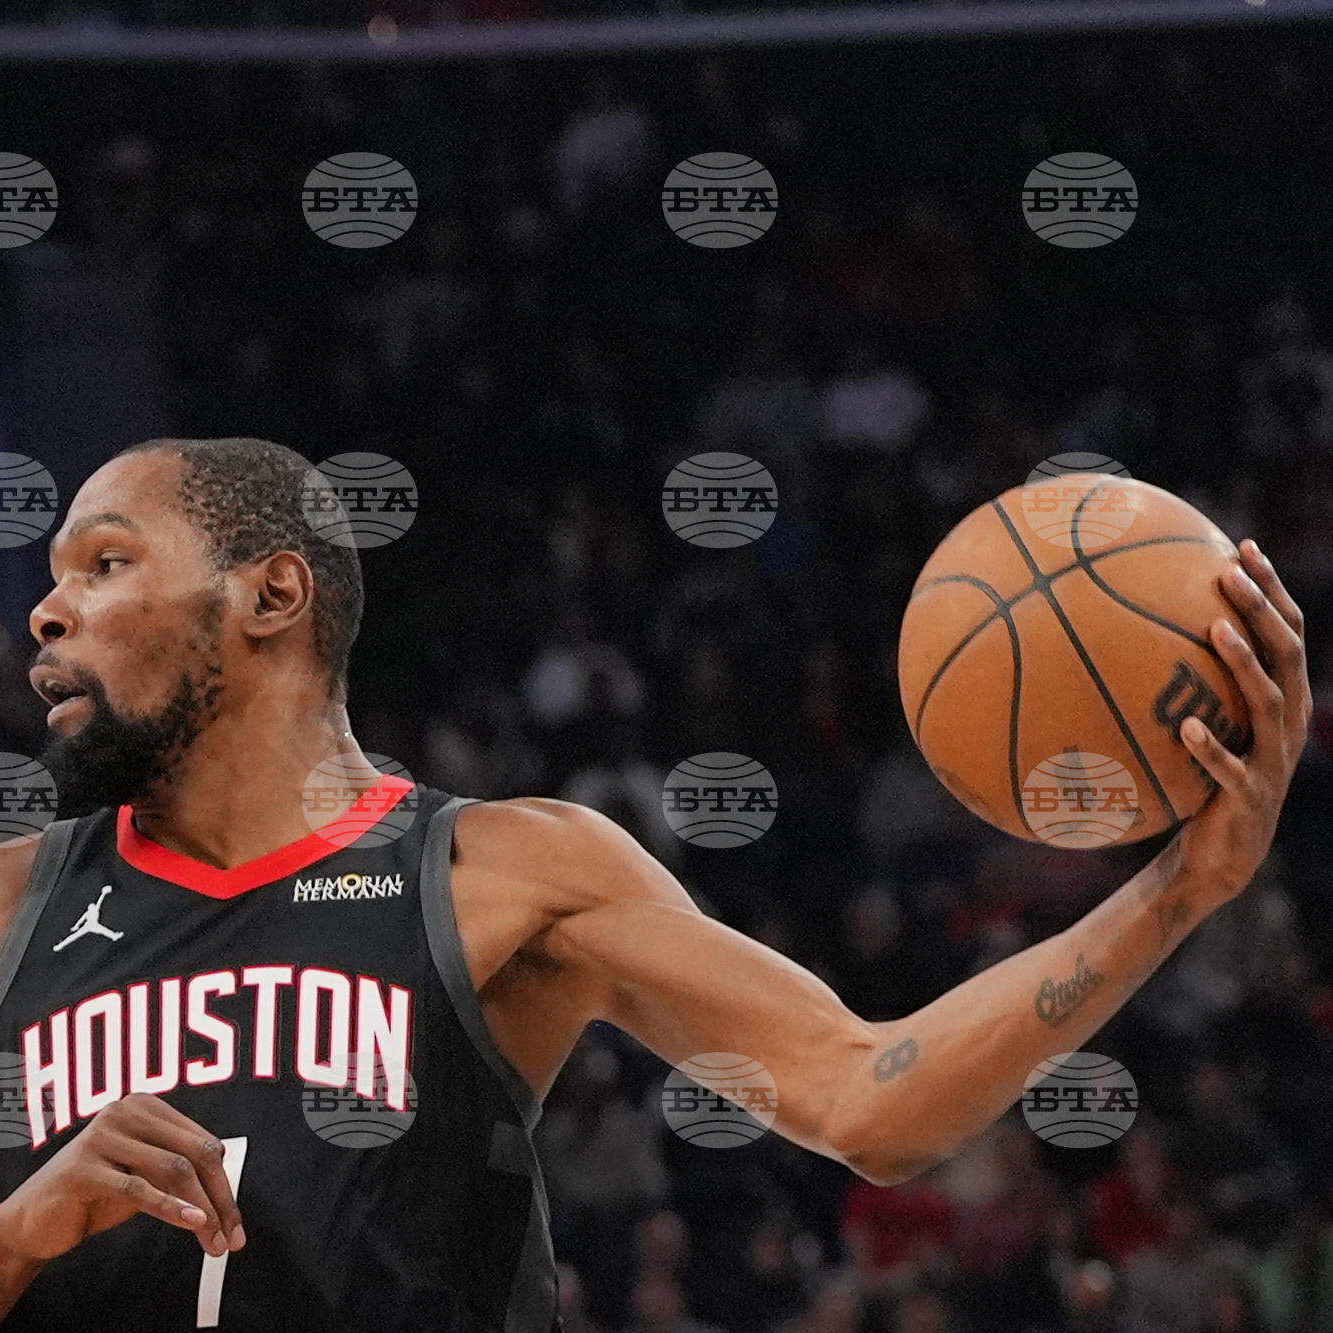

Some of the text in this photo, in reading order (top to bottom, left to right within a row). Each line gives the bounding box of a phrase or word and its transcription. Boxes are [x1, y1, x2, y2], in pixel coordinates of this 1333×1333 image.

[293, 881, 404, 902] HERMANN
[294, 873, 405, 893] MEMORIAL
[21, 964, 413, 1151] HOUSTON
